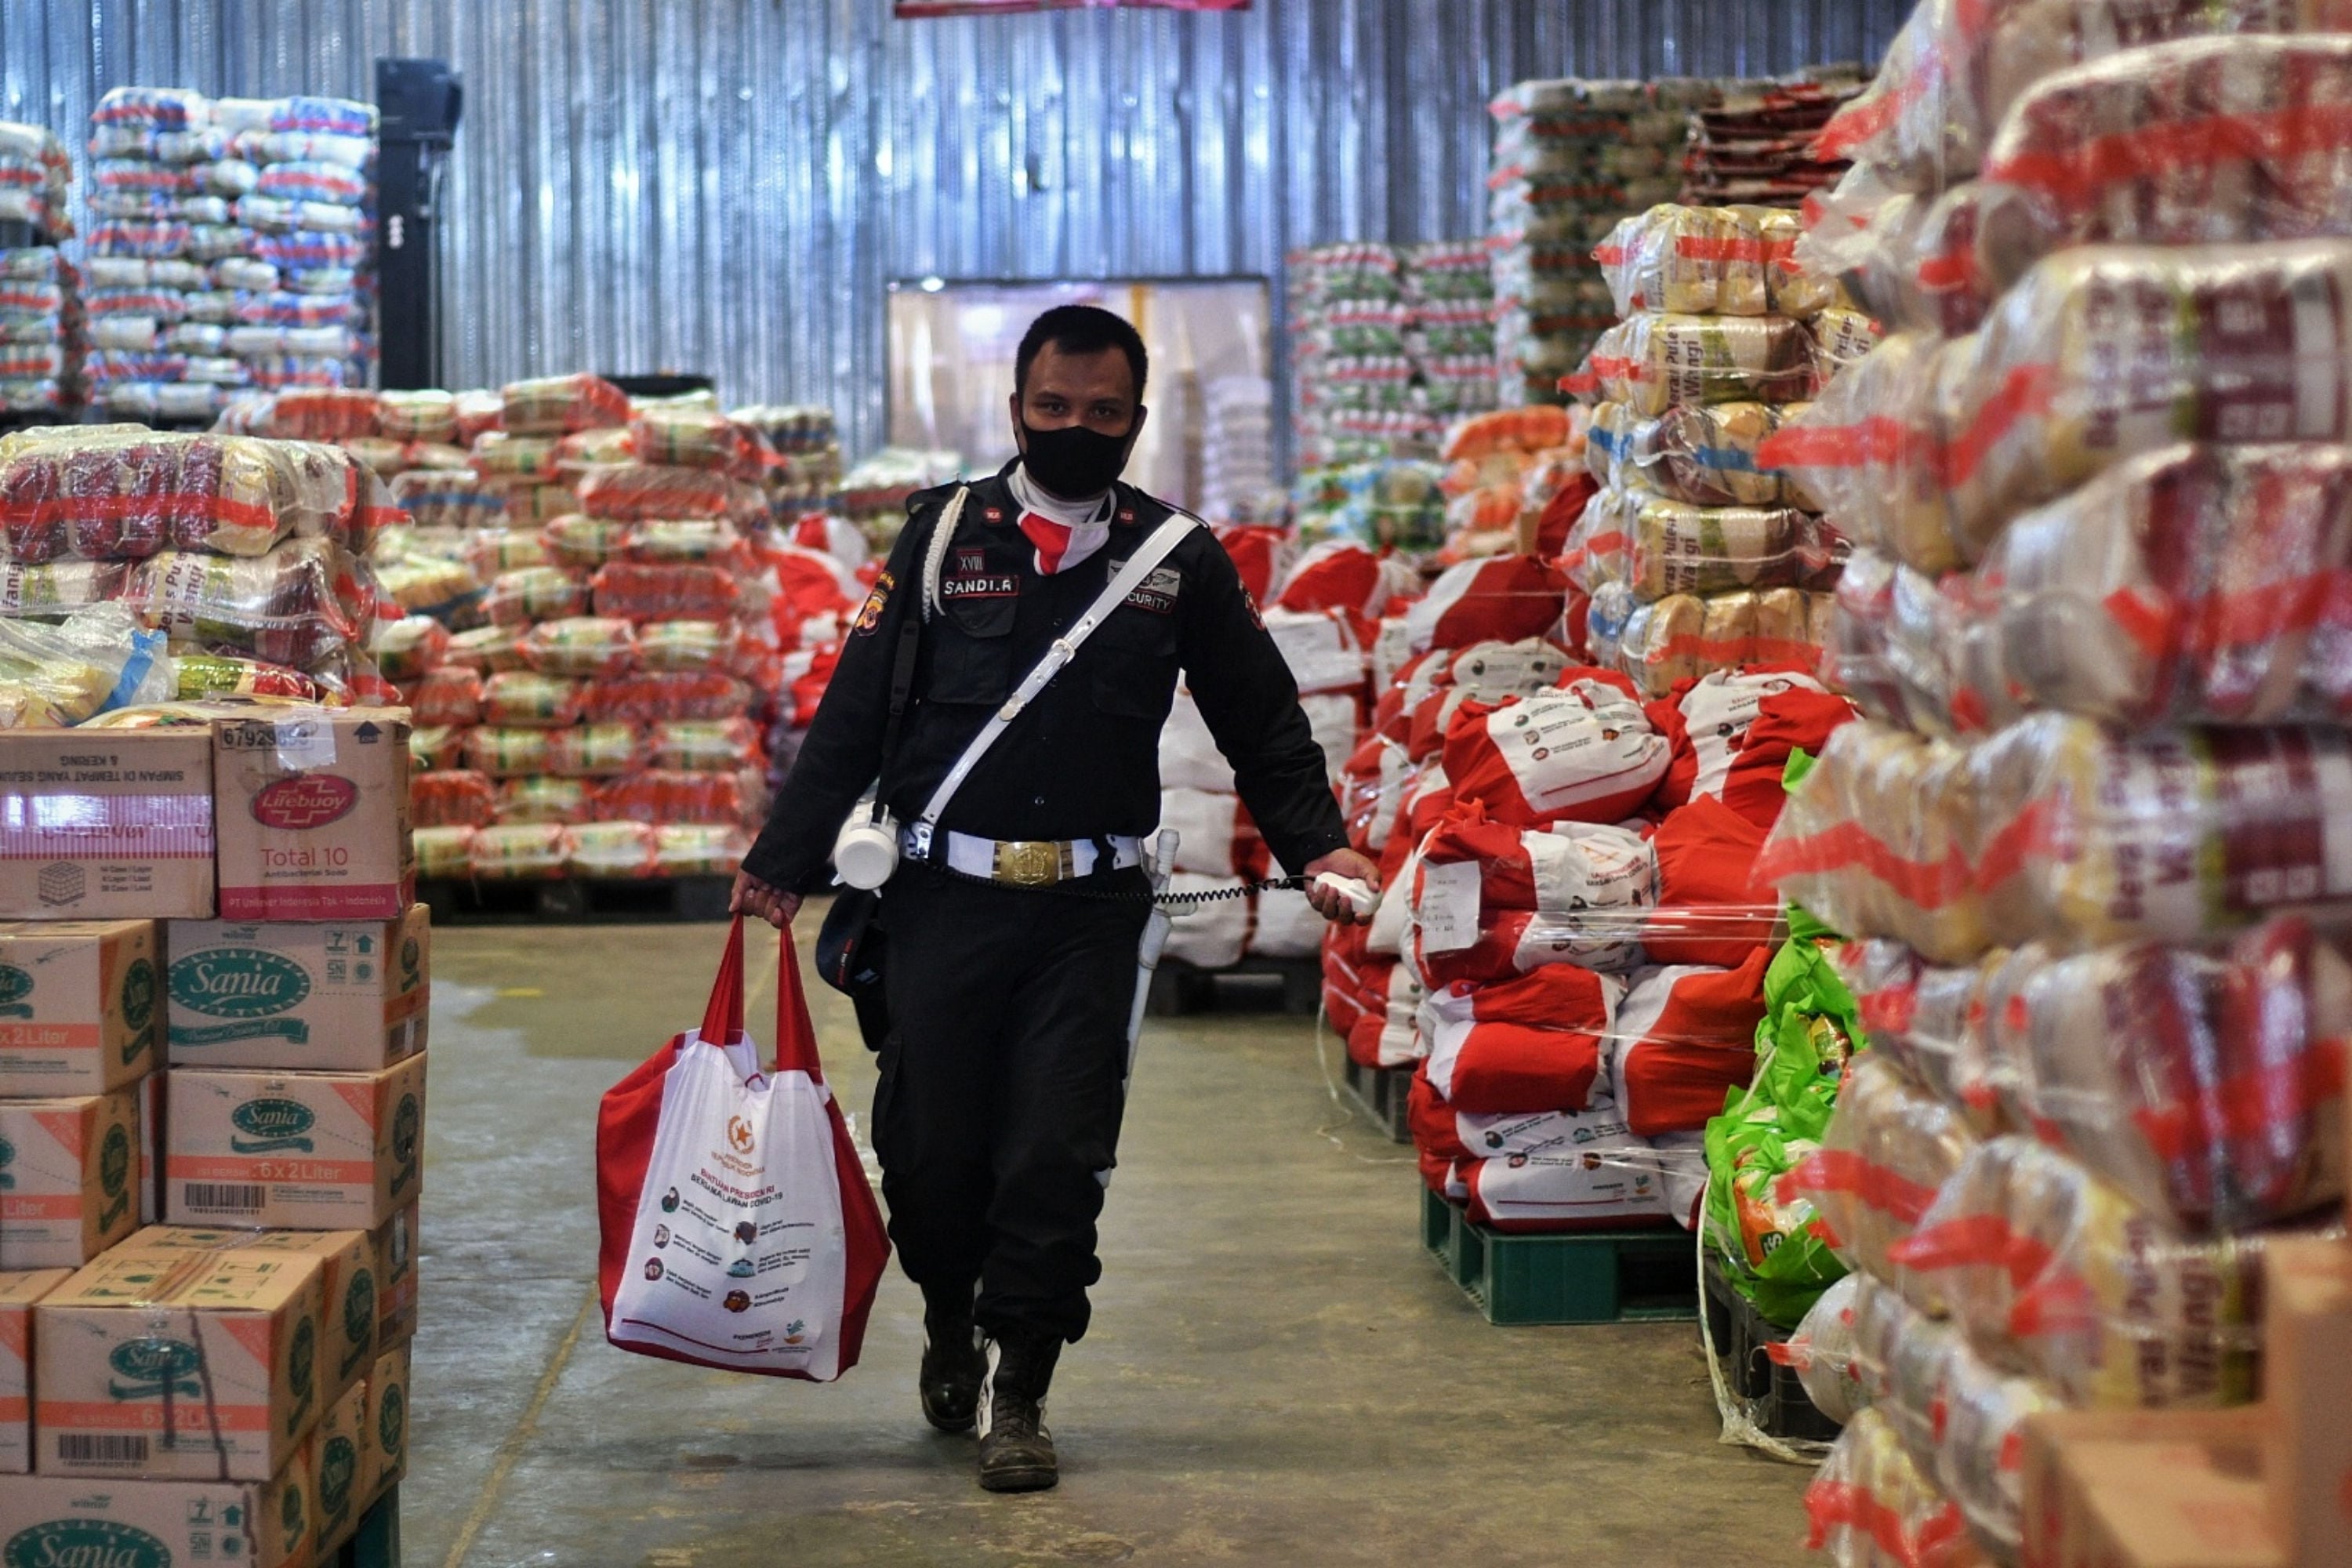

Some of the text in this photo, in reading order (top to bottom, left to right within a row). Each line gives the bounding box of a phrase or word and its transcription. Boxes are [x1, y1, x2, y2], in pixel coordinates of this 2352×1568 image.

[1127, 592, 1171, 609] CURITY
[60, 756, 107, 765] KERING
[38, 771, 71, 781] YANG
[75, 771, 119, 781] TEMPAT
[123, 771, 136, 780] DI
[140, 771, 184, 780] SIMPAN
[262, 794, 347, 809] Lifebuoy
[260, 848, 348, 866] Total 10
[190, 963, 281, 996] Sania
[27, 1029, 69, 1044] Liter
[246, 1105, 299, 1126] Sania
[287, 1162, 298, 1178] 2
[302, 1163, 341, 1180] Liter
[722, 1193, 749, 1209] LAWAN
[34, 1534, 139, 1568] Sania
